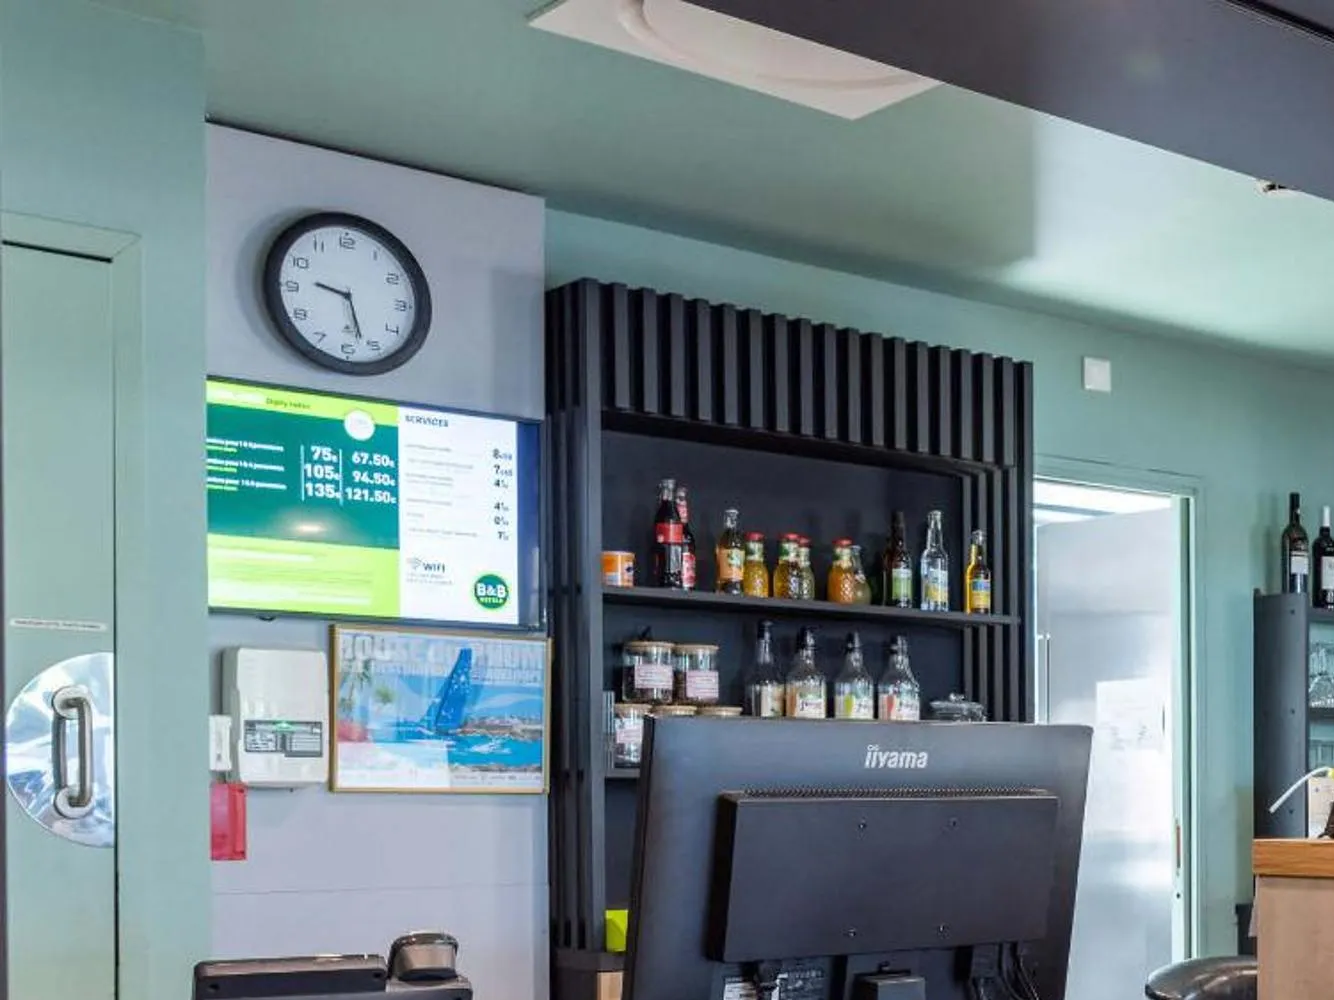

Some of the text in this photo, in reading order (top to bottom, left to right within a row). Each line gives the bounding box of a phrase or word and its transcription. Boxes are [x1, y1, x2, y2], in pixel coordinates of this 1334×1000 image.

[405, 415, 449, 427] SERVICES
[476, 583, 506, 599] B&B
[864, 744, 929, 769] iiyama
